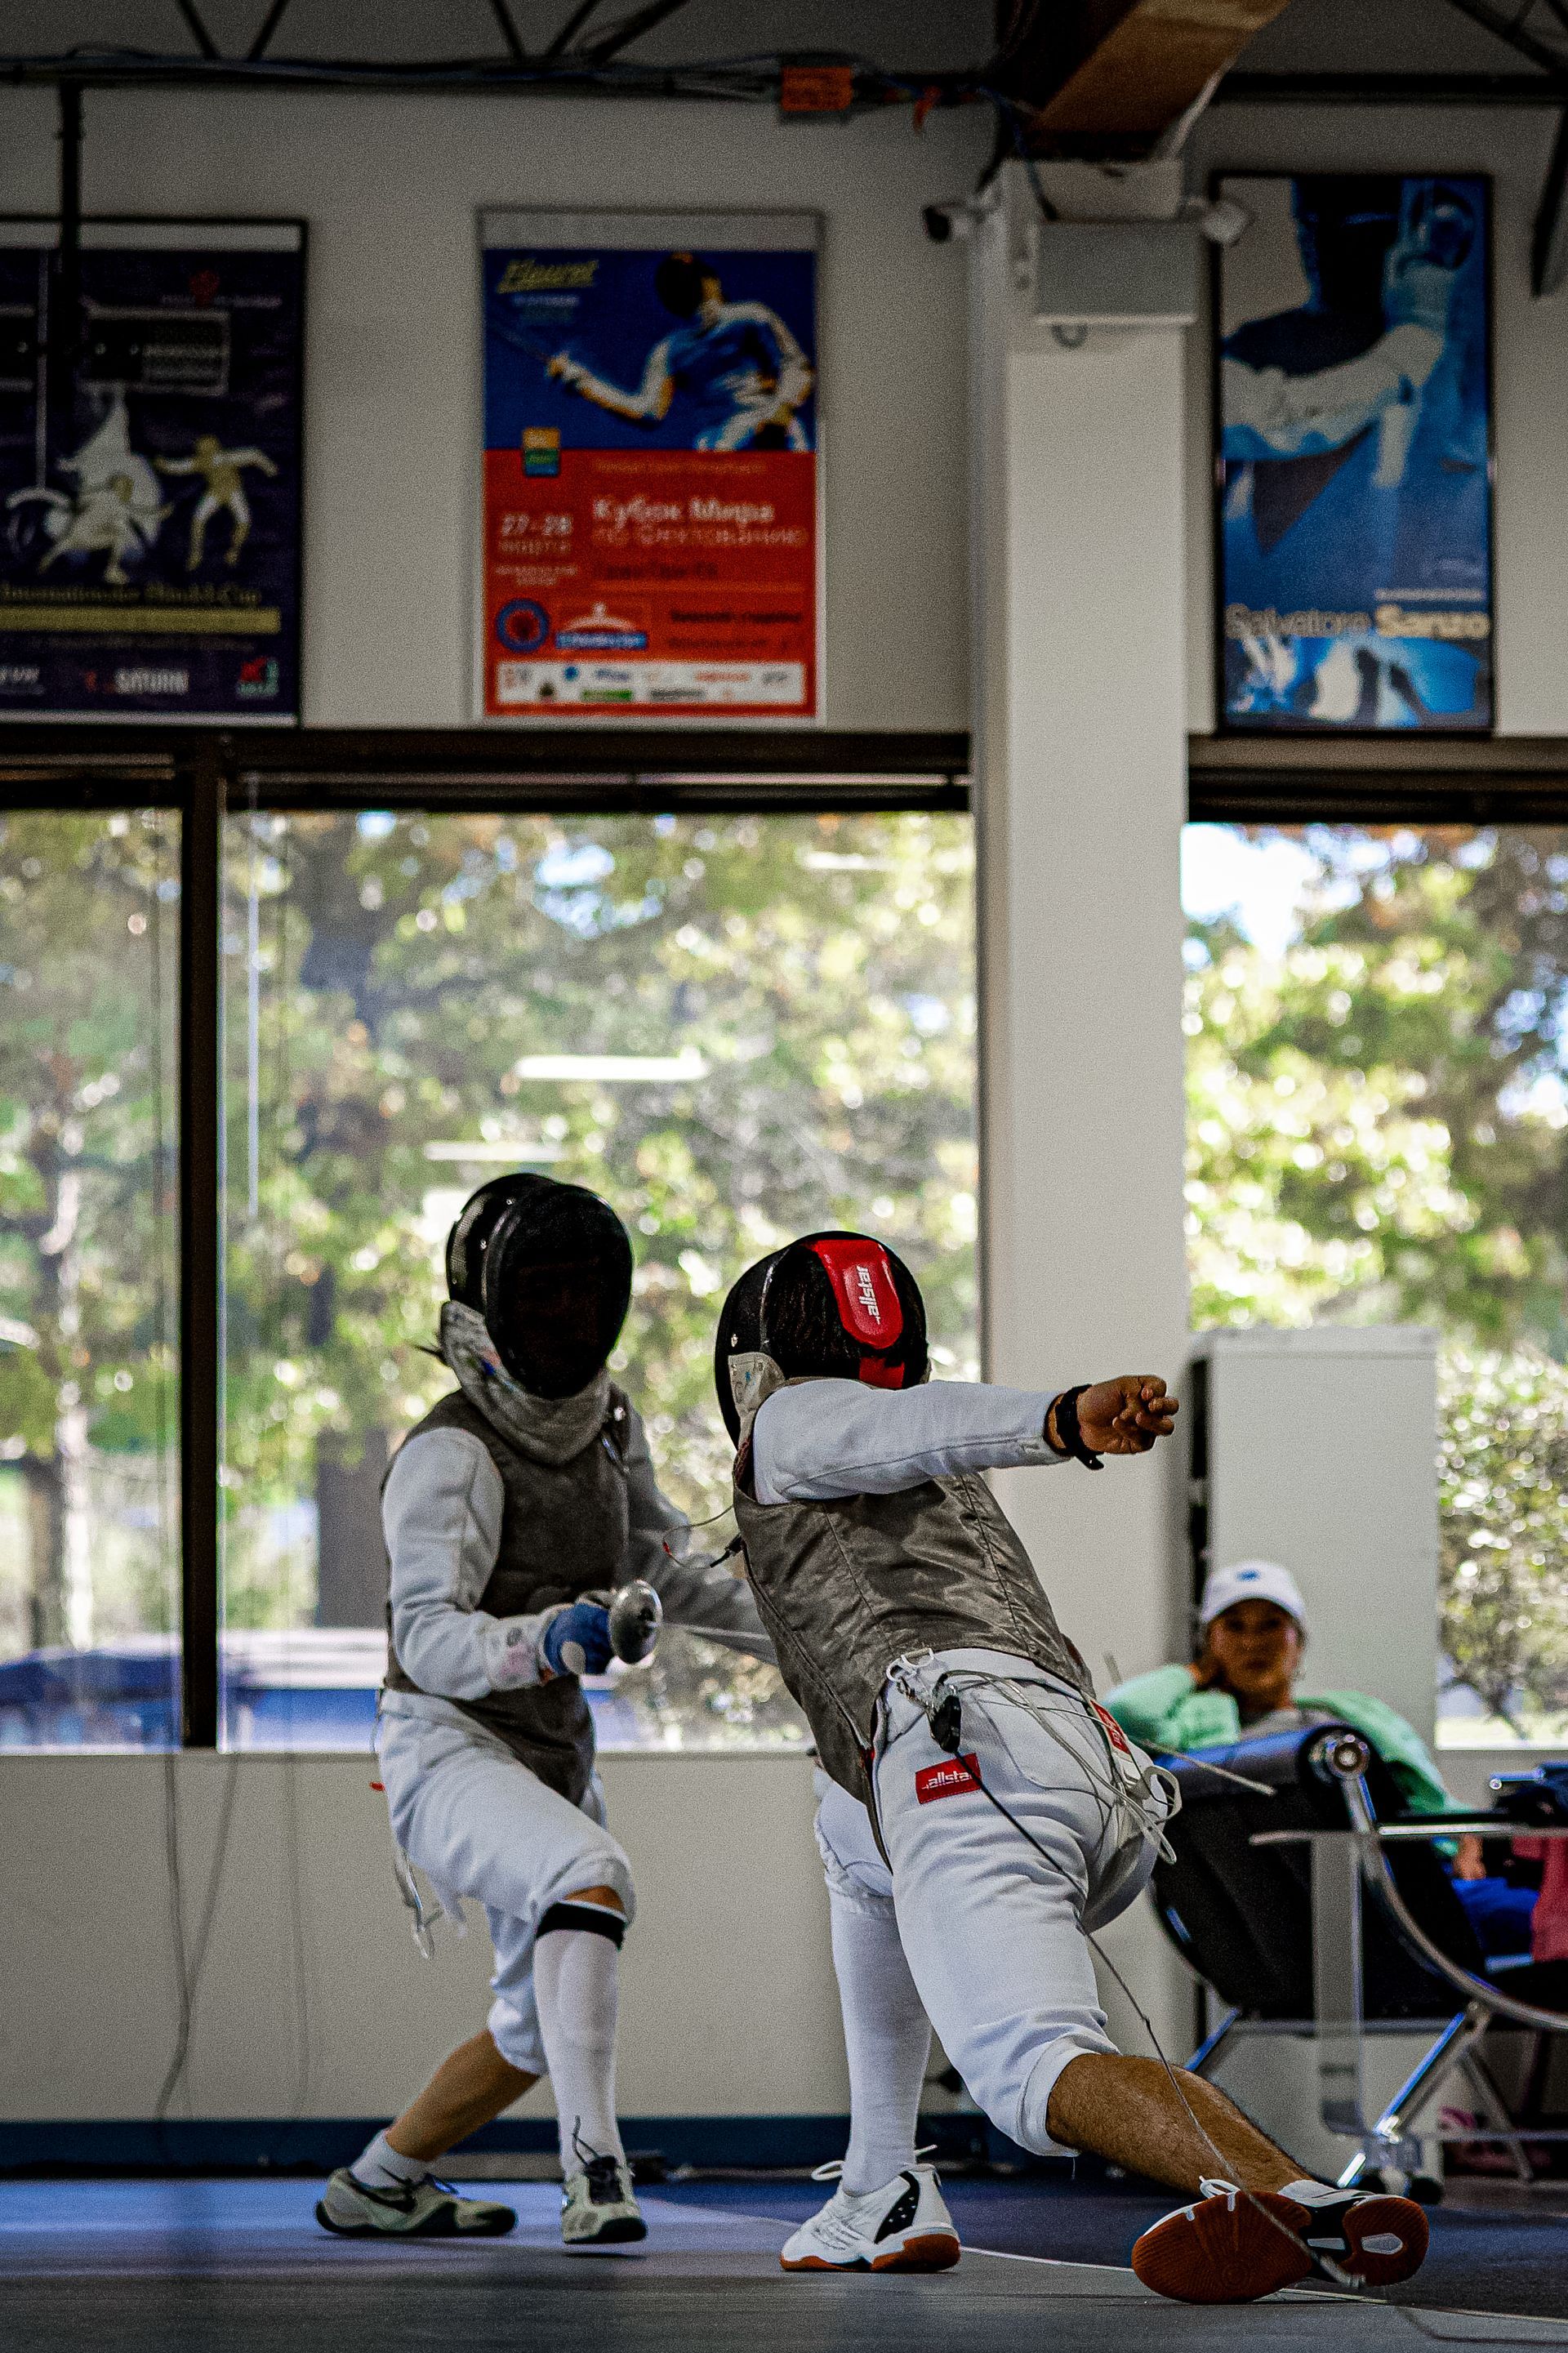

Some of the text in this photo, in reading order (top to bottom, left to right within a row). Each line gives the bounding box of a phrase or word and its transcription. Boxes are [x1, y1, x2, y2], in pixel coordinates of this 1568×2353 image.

[593, 495, 775, 531] Кубок Мира
[1225, 604, 1490, 639] Salvatore Sanzo
[857, 1265, 880, 1316] allstar
